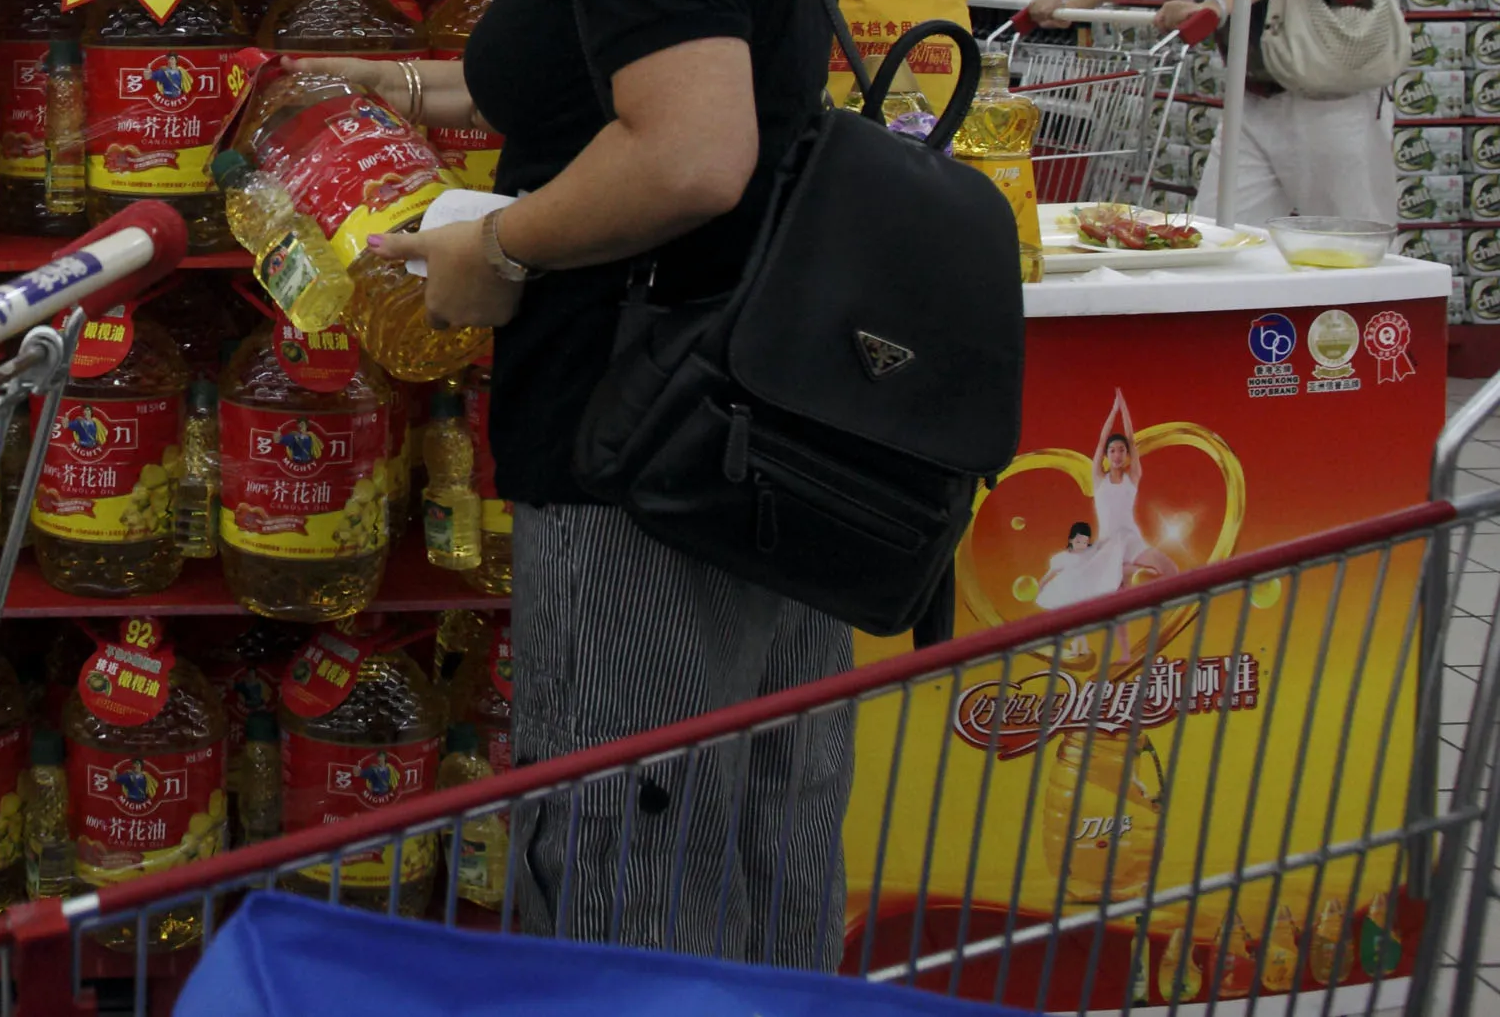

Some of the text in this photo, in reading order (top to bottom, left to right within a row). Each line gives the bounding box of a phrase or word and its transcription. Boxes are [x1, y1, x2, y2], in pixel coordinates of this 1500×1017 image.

[124, 74, 144, 94] 多
[153, 93, 188, 111] MIGHTY
[143, 114, 202, 138] 芥花油
[1399, 187, 1431, 210] chill
[1248, 375, 1299, 386] HONG KONG
[1250, 385, 1298, 397] TOP BRAND
[70, 446, 104, 459] MIGHTY
[256, 436, 273, 455] 多
[282, 458, 318, 475] MIGHTY
[61, 466, 117, 488] 芥花油
[272, 480, 332, 504] 芥花油
[92, 773, 109, 792] 多
[334, 769, 352, 789] 多
[117, 796, 154, 814] MIGHTY
[363, 791, 395, 806] MIGHTY
[108, 817, 167, 841] 芥花油
